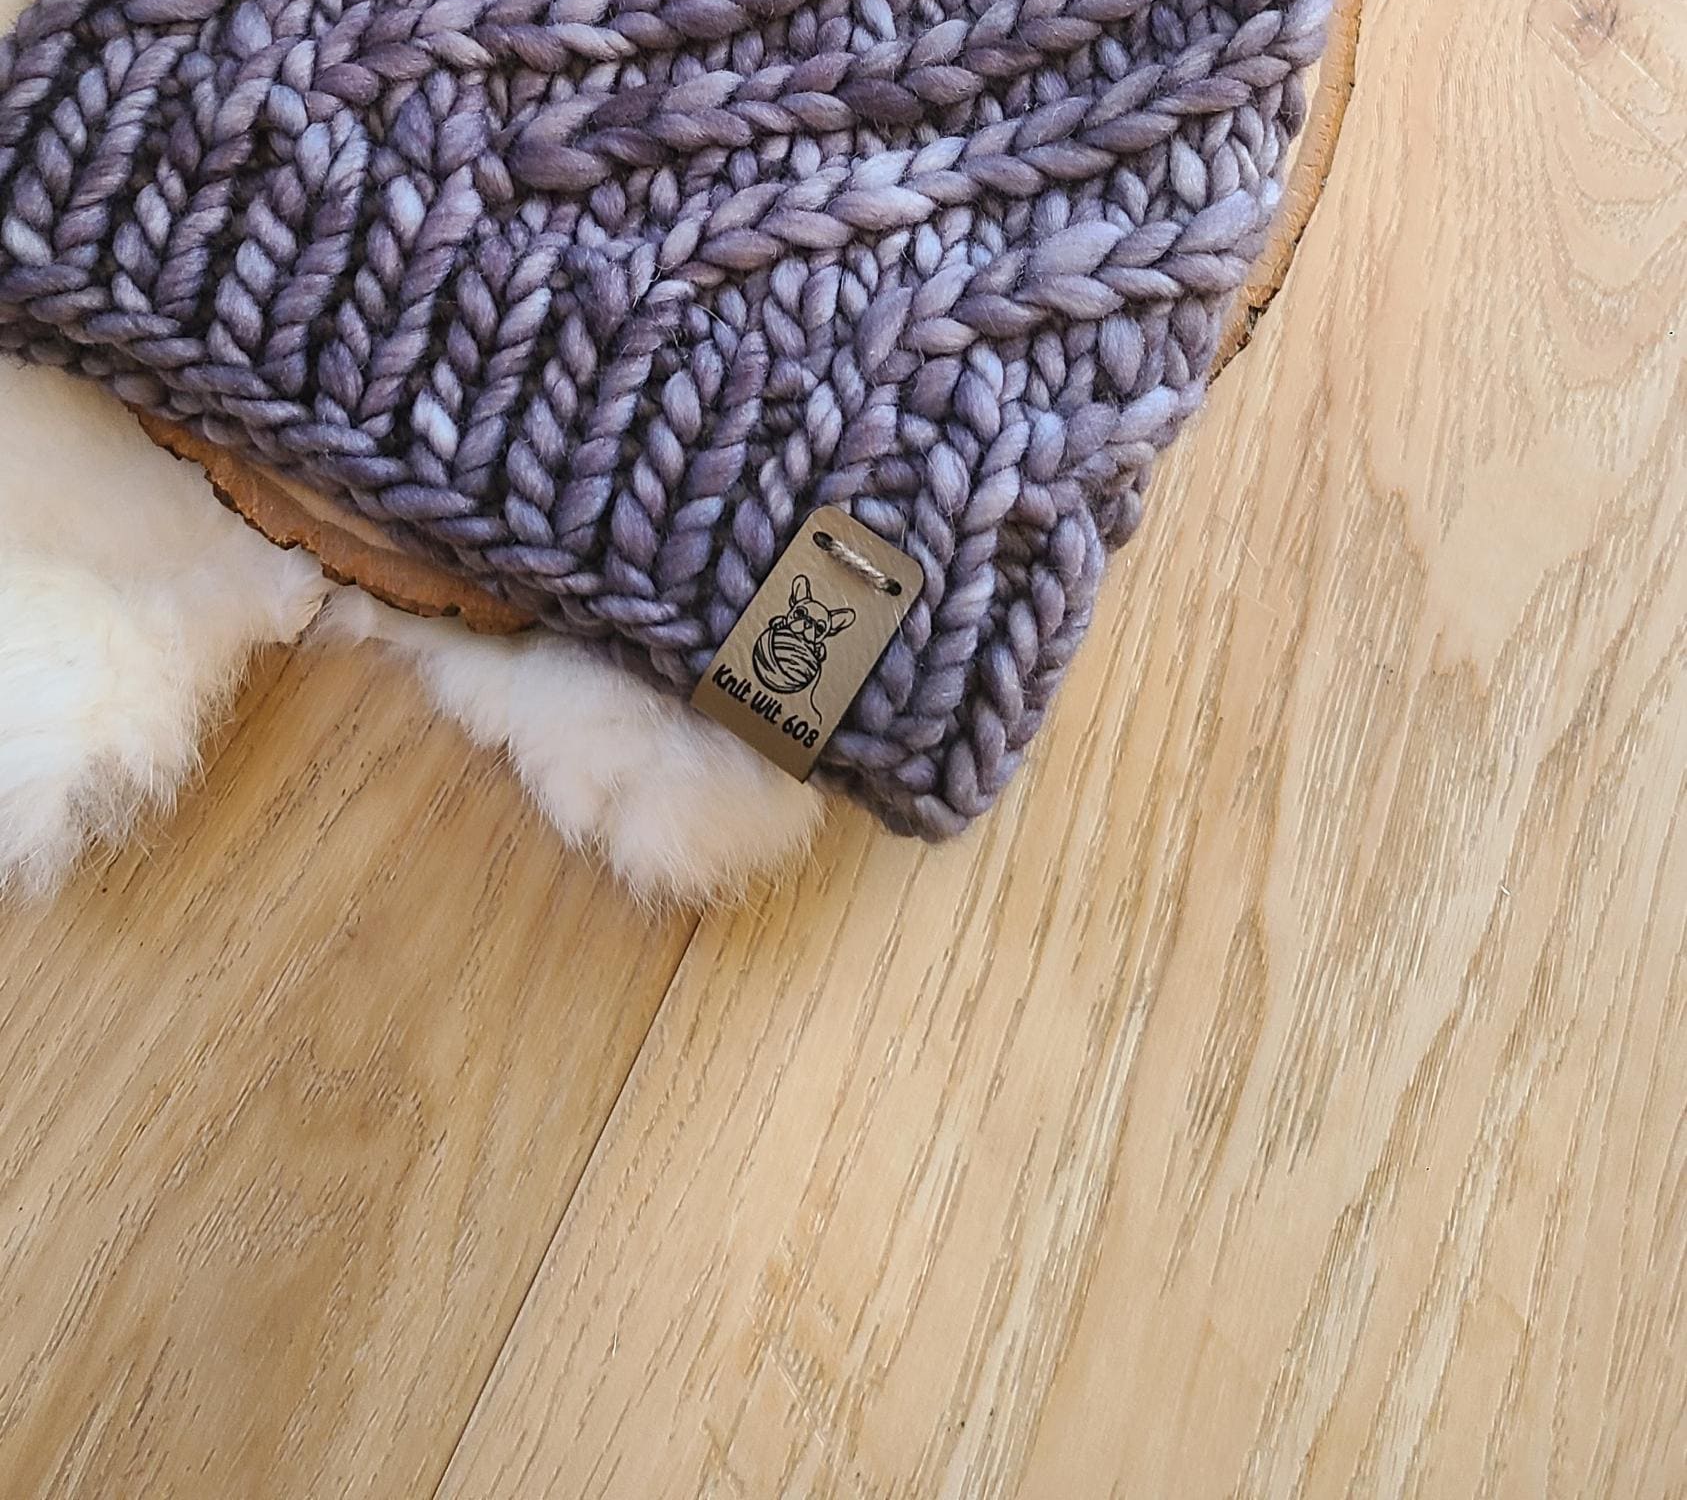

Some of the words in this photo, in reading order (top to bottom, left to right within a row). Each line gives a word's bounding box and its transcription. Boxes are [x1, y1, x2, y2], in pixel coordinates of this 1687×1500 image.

[712, 664, 752, 704] Knit
[750, 690, 783, 725] Wit
[782, 714, 819, 749] 608
